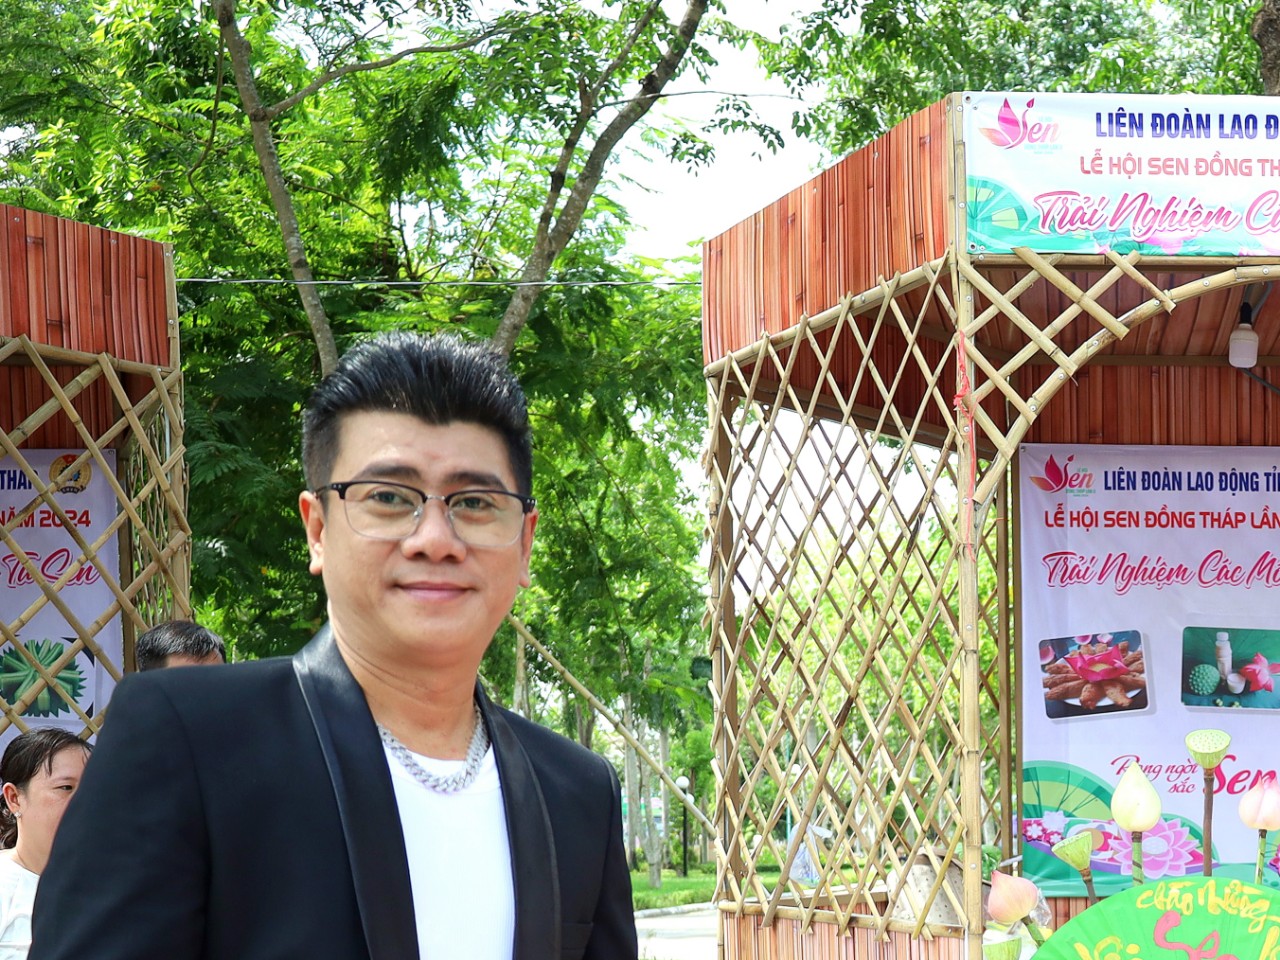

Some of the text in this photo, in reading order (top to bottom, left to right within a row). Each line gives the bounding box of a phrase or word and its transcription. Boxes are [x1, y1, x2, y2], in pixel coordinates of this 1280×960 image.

[1095, 107, 1144, 138] LIÊN
[1151, 108, 1211, 139] ĐOÀN
[1218, 113, 1258, 140] LAO
[1080, 148, 1103, 175] LỄ
[1109, 152, 1142, 180] HỘI
[1148, 158, 1187, 176] SEN
[1194, 151, 1252, 177] ĐỒNG
[1034, 190, 1107, 233] Trải
[1109, 192, 1241, 242] Nghiệm
[1104, 467, 1137, 491] LIÊN
[1141, 467, 1182, 491] ĐOÀN
[1187, 472, 1214, 491] LAO
[1218, 468, 1260, 496] ĐỘNG
[39, 510, 91, 528] 2024
[1045, 503, 1065, 528] LỄ
[1070, 506, 1099, 532] HỘI
[1103, 510, 1140, 528] SEN
[1144, 504, 1195, 529] ĐỒNG
[1199, 507, 1246, 529] THÁP
[41, 547, 99, 586] Sn
[1042, 551, 1098, 587] Trải
[1098, 552, 1196, 595] Nghiệm
[1198, 550, 1246, 588] Các
